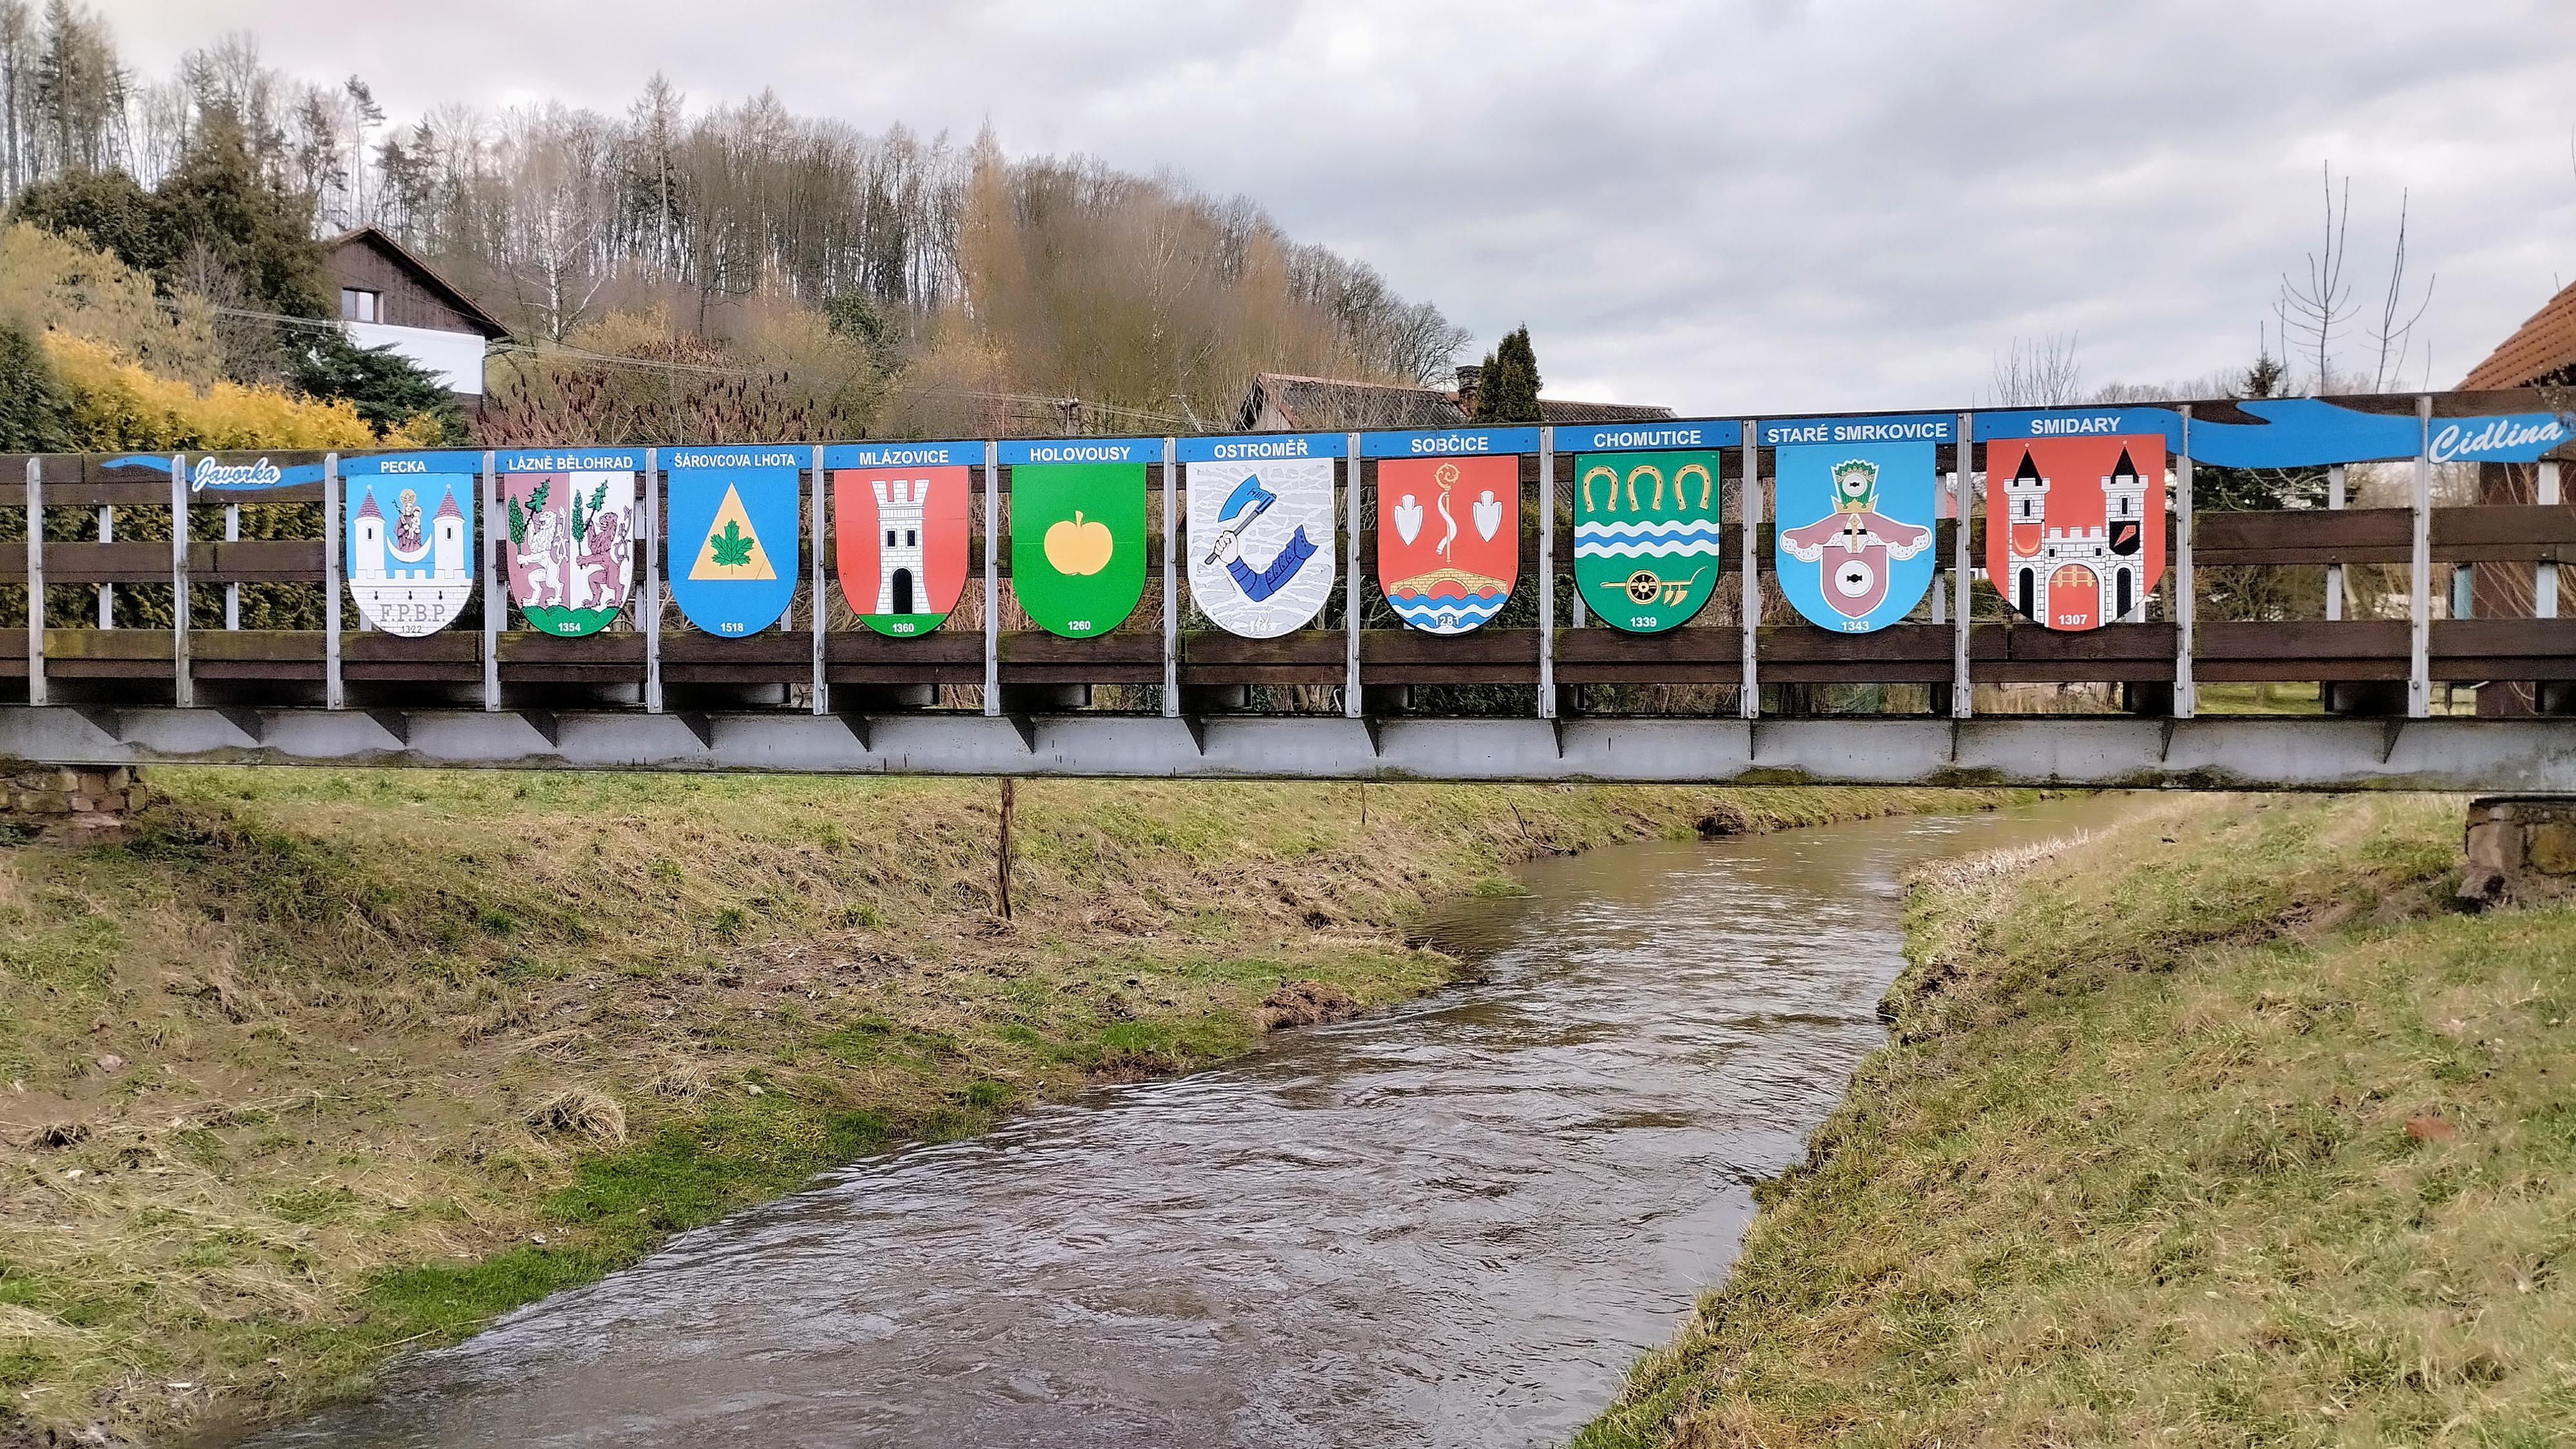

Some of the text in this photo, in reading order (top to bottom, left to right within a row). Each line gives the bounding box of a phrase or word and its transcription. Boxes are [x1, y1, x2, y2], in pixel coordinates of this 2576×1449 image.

[1767, 422, 1948, 443] STARÉ SMRKOVICE
[2031, 417, 2120, 435] SMIDARY
[1410, 435, 1489, 453] SOBČICE
[1593, 430, 1701, 448] CHOMUTICE
[2429, 420, 2563, 463] Cidlina
[1030, 446, 1131, 462] HOLOVOUSY
[1214, 440, 1308, 457] OSTROMĚŘ
[508, 453, 634, 470] LÁZNĚ BĚLOHRAD
[674, 453, 796, 468] ŠÁROVCOVA LHOTA
[859, 450, 949, 464] MLÁZOVICE
[381, 460, 426, 473] PECKA
[192, 457, 280, 492] Javorka
[379, 604, 446, 622] F.P.B.P.
[2058, 613, 2087, 625] 1307
[558, 622, 581, 632] 1354
[720, 622, 744, 632] 1518
[892, 622, 914, 633] 1360
[1067, 620, 1091, 631] 1260
[1434, 615, 1460, 627] 1281
[1629, 616, 1657, 627] 1339
[1841, 620, 1870, 632] 1343
[401, 625, 422, 633] 1322
